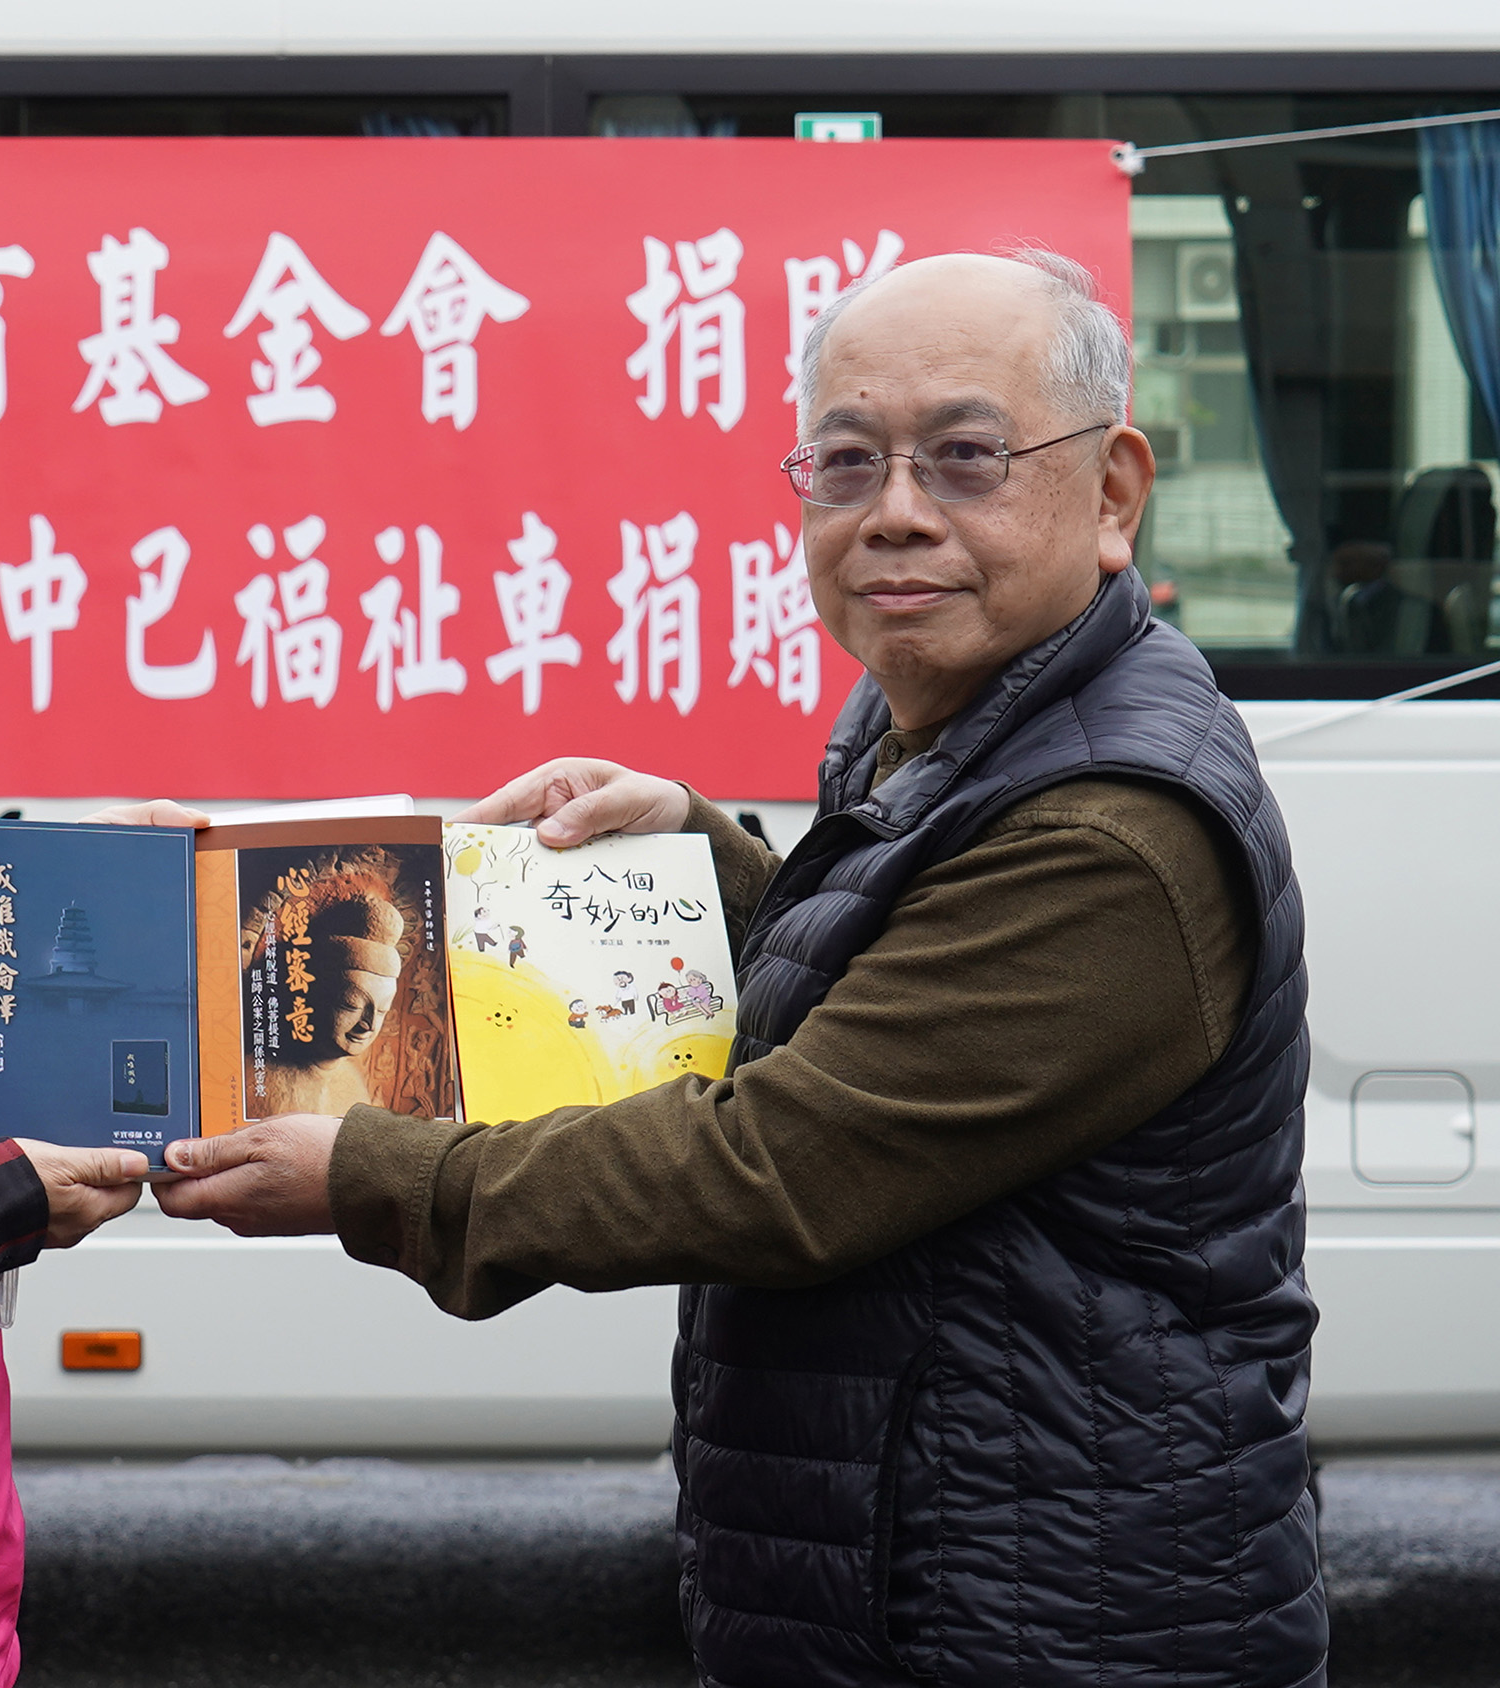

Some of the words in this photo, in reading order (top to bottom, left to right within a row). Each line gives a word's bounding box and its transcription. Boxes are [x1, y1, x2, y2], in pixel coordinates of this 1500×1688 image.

[583, 864, 654, 892] 八個
[541, 879, 707, 933] 奇妙的心
[277, 867, 316, 1043] 心經密意
